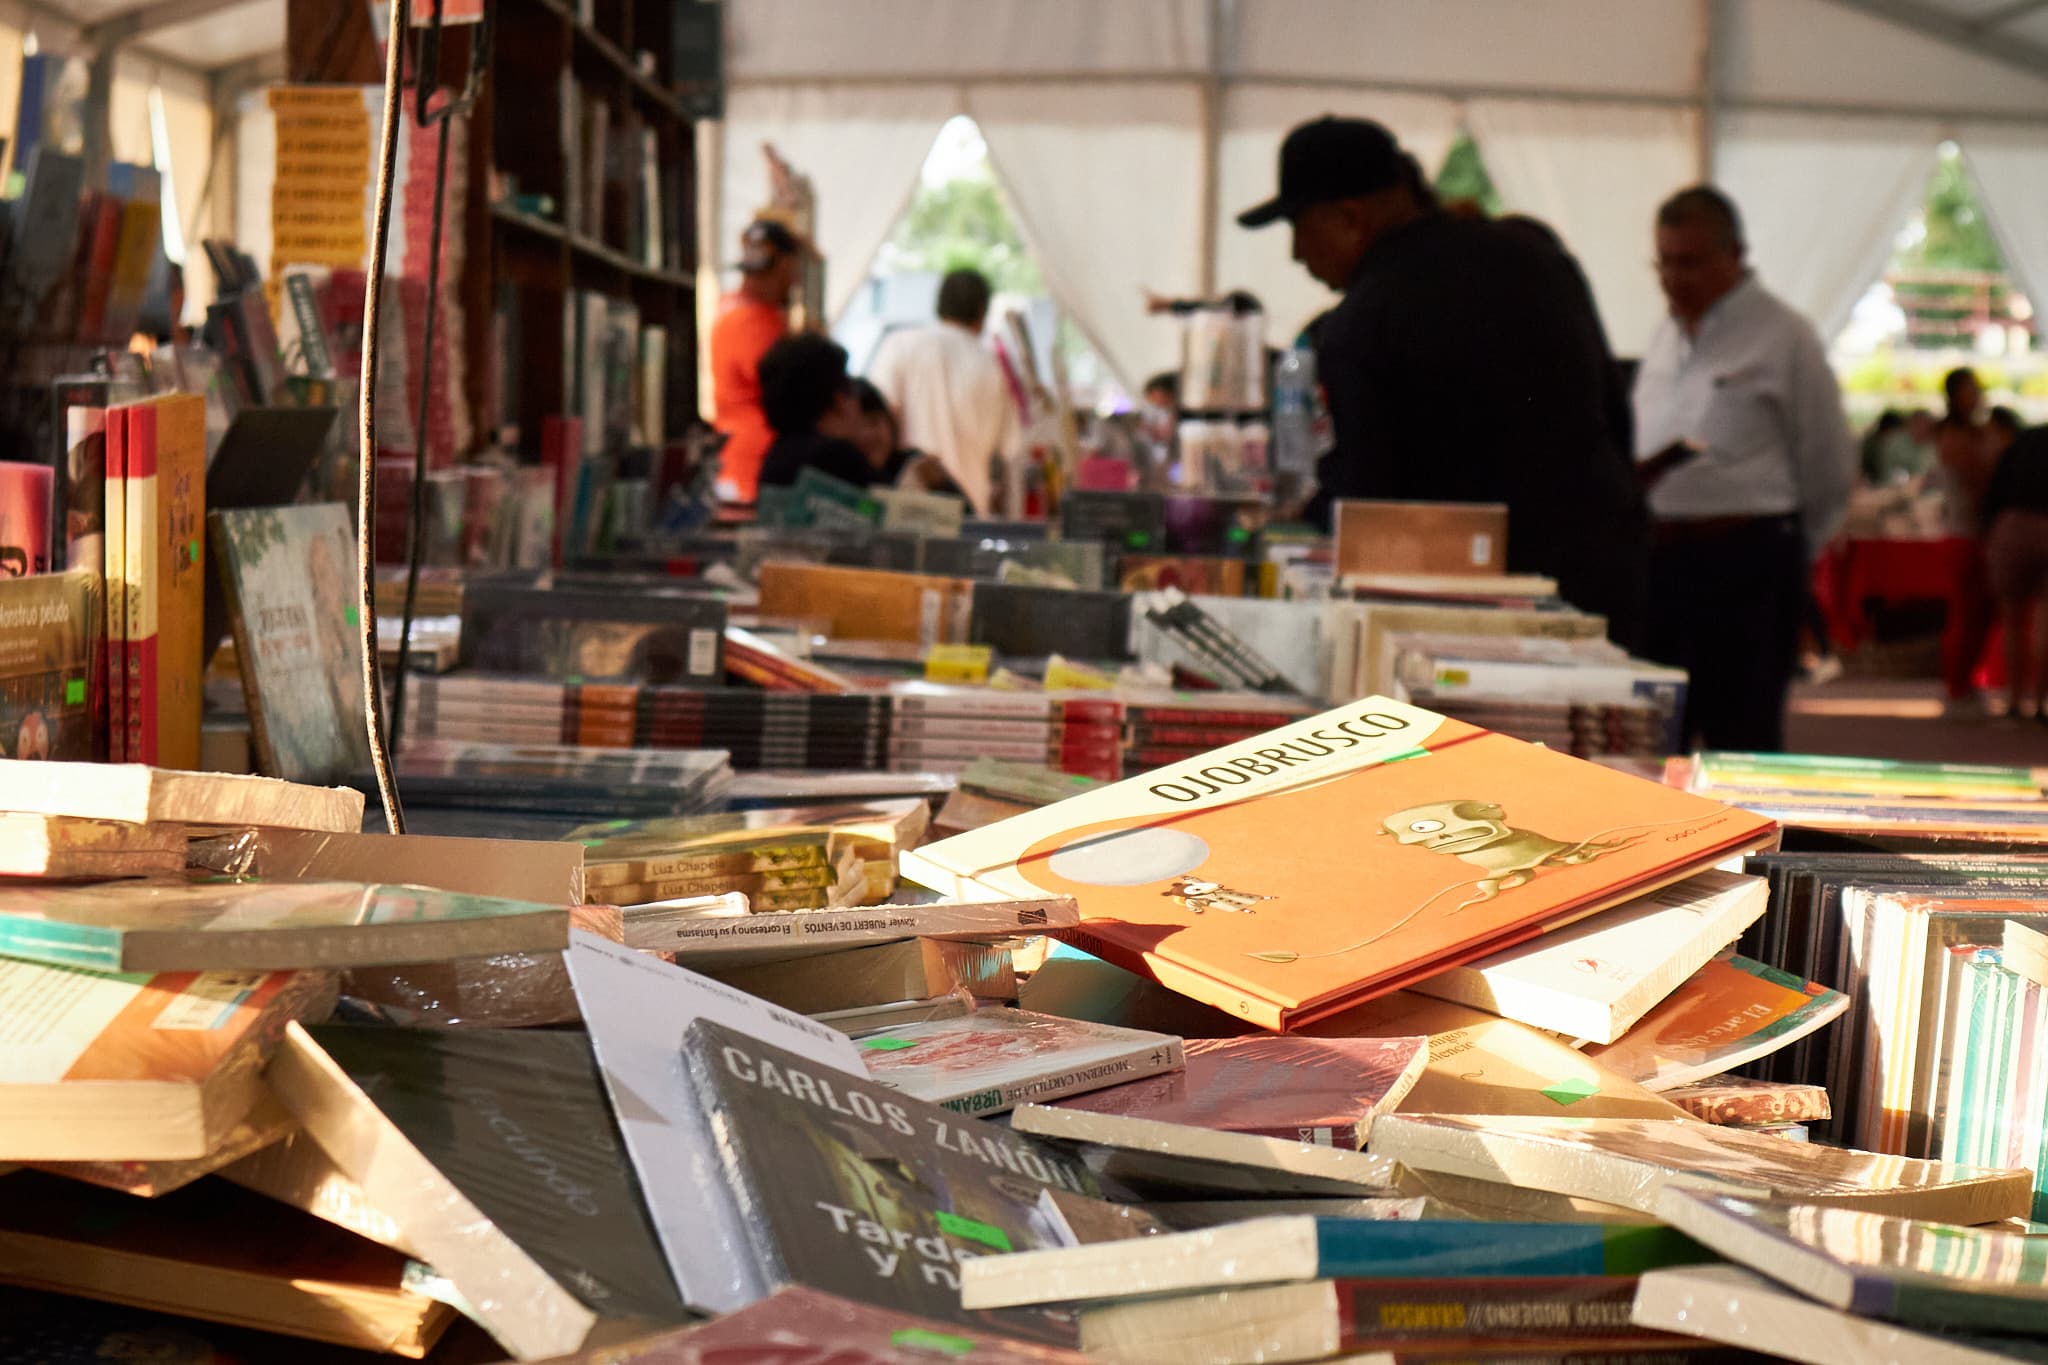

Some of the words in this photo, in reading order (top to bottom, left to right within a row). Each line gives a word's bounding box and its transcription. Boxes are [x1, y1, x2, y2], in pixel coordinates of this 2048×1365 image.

[0, 604, 38, 628] onstruo
[1149, 713, 1410, 802] OJOBRUSCO
[652, 862, 674, 875] Luz
[662, 882, 684, 894] Luz
[738, 925, 782, 935] cortesano
[783, 925, 791, 934] El
[804, 921, 840, 934] VENTÓS
[840, 921, 853, 931] DE
[853, 919, 887, 931] RUBERT
[889, 917, 916, 928] Xavier
[676, 926, 718, 938] fantasma
[719, 927, 730, 936] su
[731, 927, 738, 936] y
[1751, 1003, 1773, 1019] El
[1712, 1016, 1747, 1038] arte
[1429, 1030, 1469, 1049] migos
[1079, 1060, 1128, 1085] MODERNA
[1006, 1087, 1021, 1100] DE
[1022, 1074, 1077, 1097] CARTILLA
[941, 1089, 1003, 1112] URBAN
[722, 1047, 916, 1136] CARLOS
[927, 1117, 1084, 1194] ZANÓN
[865, 1247, 900, 1278] y
[920, 1262, 963, 1291] n
[1378, 1303, 1466, 1328] GRAMSCI
[1485, 1303, 1570, 1328] MODERNO
[1575, 1303, 1632, 1327] STADO
